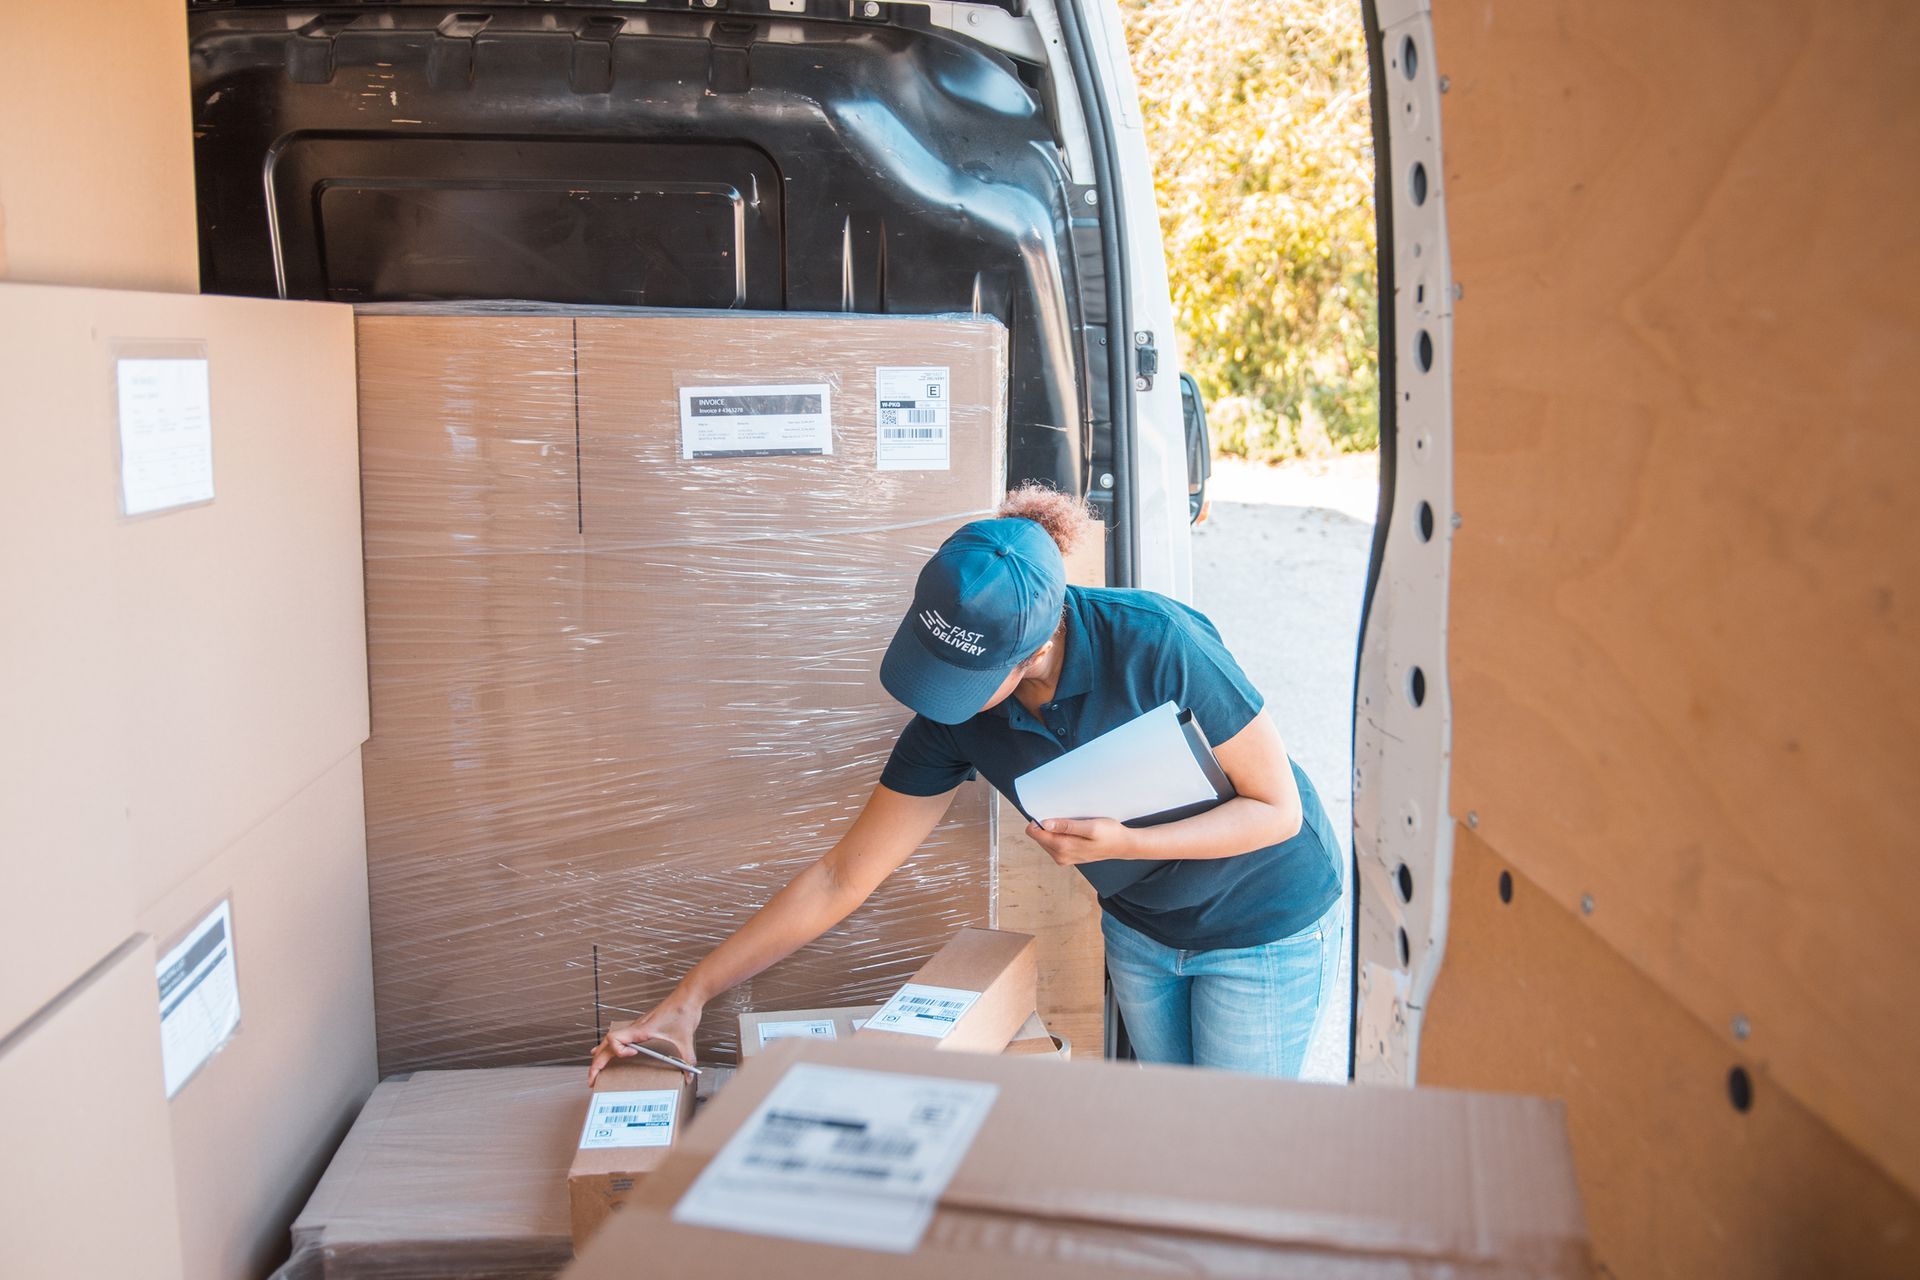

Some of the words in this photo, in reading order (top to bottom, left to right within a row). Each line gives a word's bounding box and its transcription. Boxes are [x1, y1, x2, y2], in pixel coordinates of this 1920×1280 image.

[930, 386, 937, 396] E
[932, 626, 987, 657] DELIVERY
[950, 625, 984, 644] FAST
